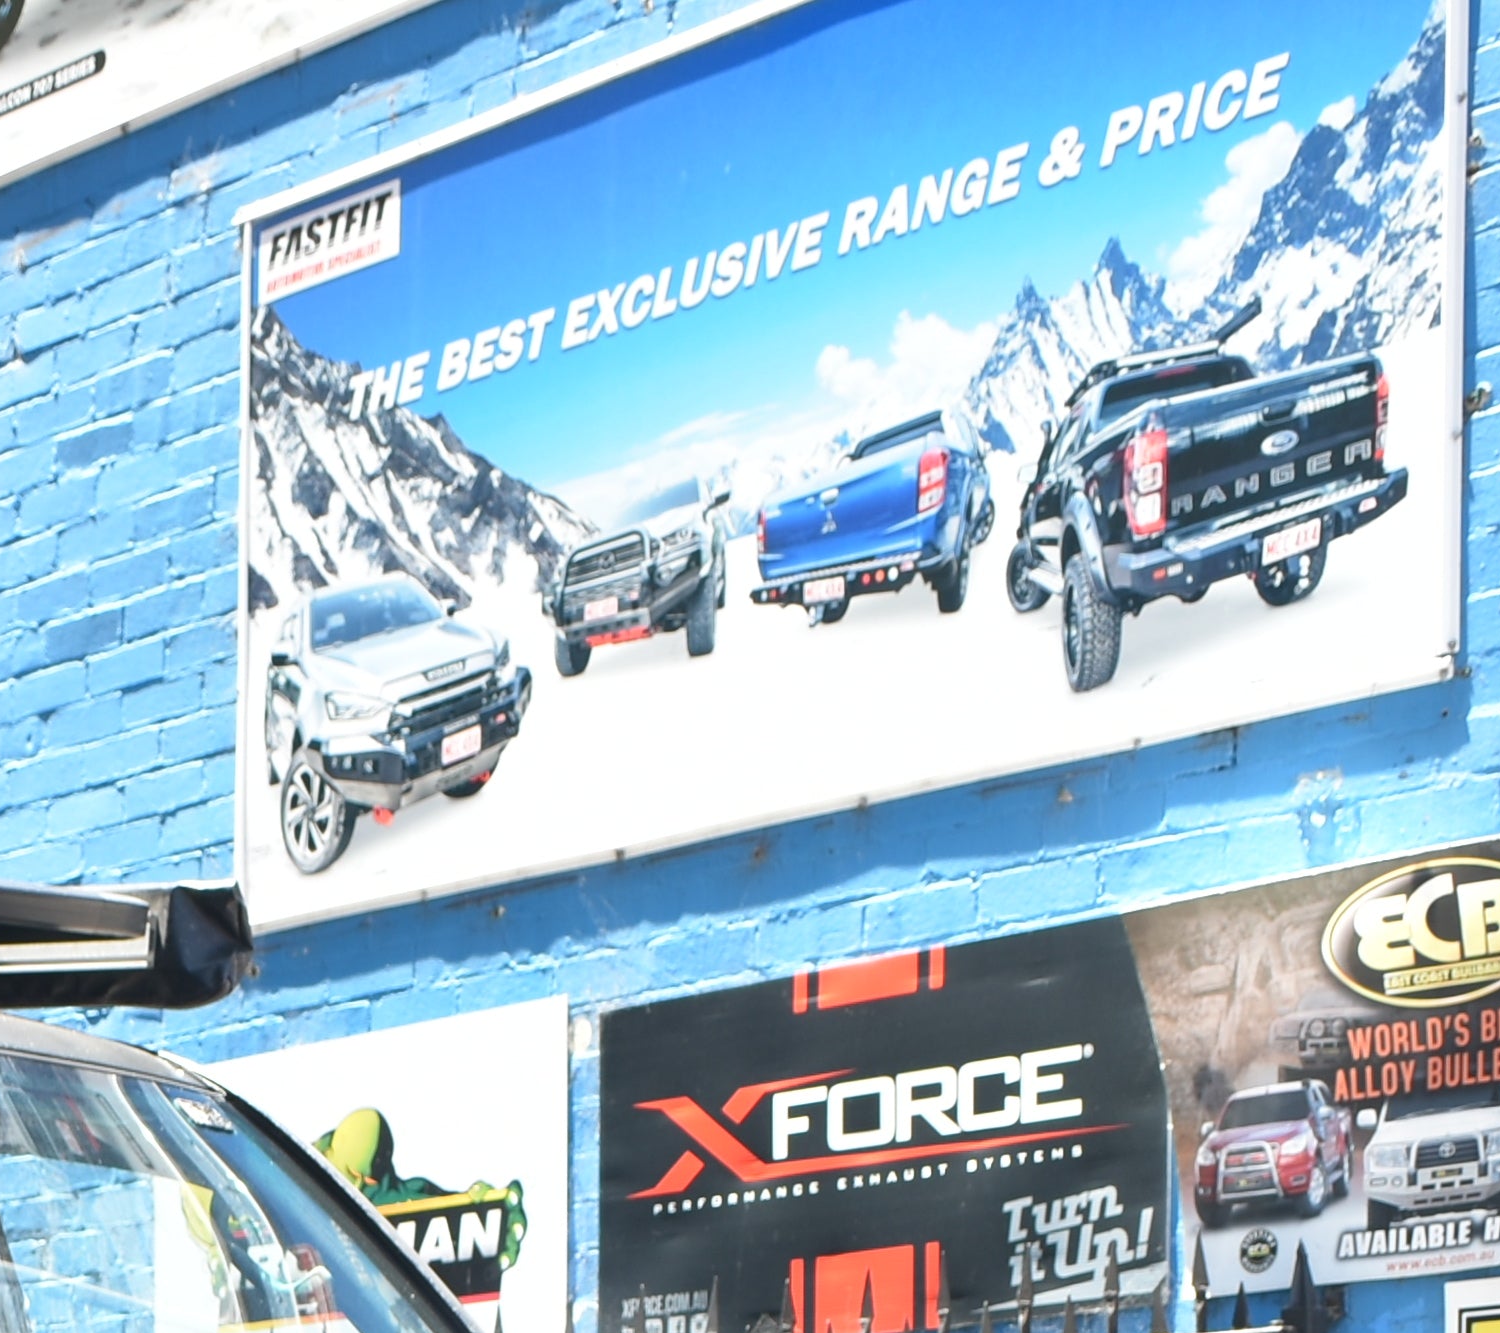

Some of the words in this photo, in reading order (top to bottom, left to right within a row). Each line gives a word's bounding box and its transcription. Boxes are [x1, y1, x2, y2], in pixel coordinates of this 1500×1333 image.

[267, 189, 394, 272] FASTFIT
[349, 350, 431, 421] THE
[436, 307, 556, 392] BEST
[560, 211, 831, 351] EXCLUSIVE
[836, 141, 1030, 257] RANGE
[1037, 124, 1086, 188] &
[1099, 51, 1291, 169] PRICE
[1170, 438, 1372, 518] RANGER
[1346, 1012, 1476, 1061] WORLD'S
[1333, 1059, 1416, 1104] ALLOY
[627, 1043, 1084, 1200] XFORCE
[652, 1180, 820, 1216] PERFORMANCE
[836, 1162, 950, 1191] EXHAUST
[965, 1143, 1083, 1174] SYSTEMS
[1002, 1184, 1125, 1243] Turn
[1047, 1206, 1155, 1284] Up!
[1338, 1219, 1472, 1259] AVAILABLE
[1386, 1249, 1496, 1273] www.ecb.com.au
[621, 1289, 709, 1319] XFRCE.COM.AU
